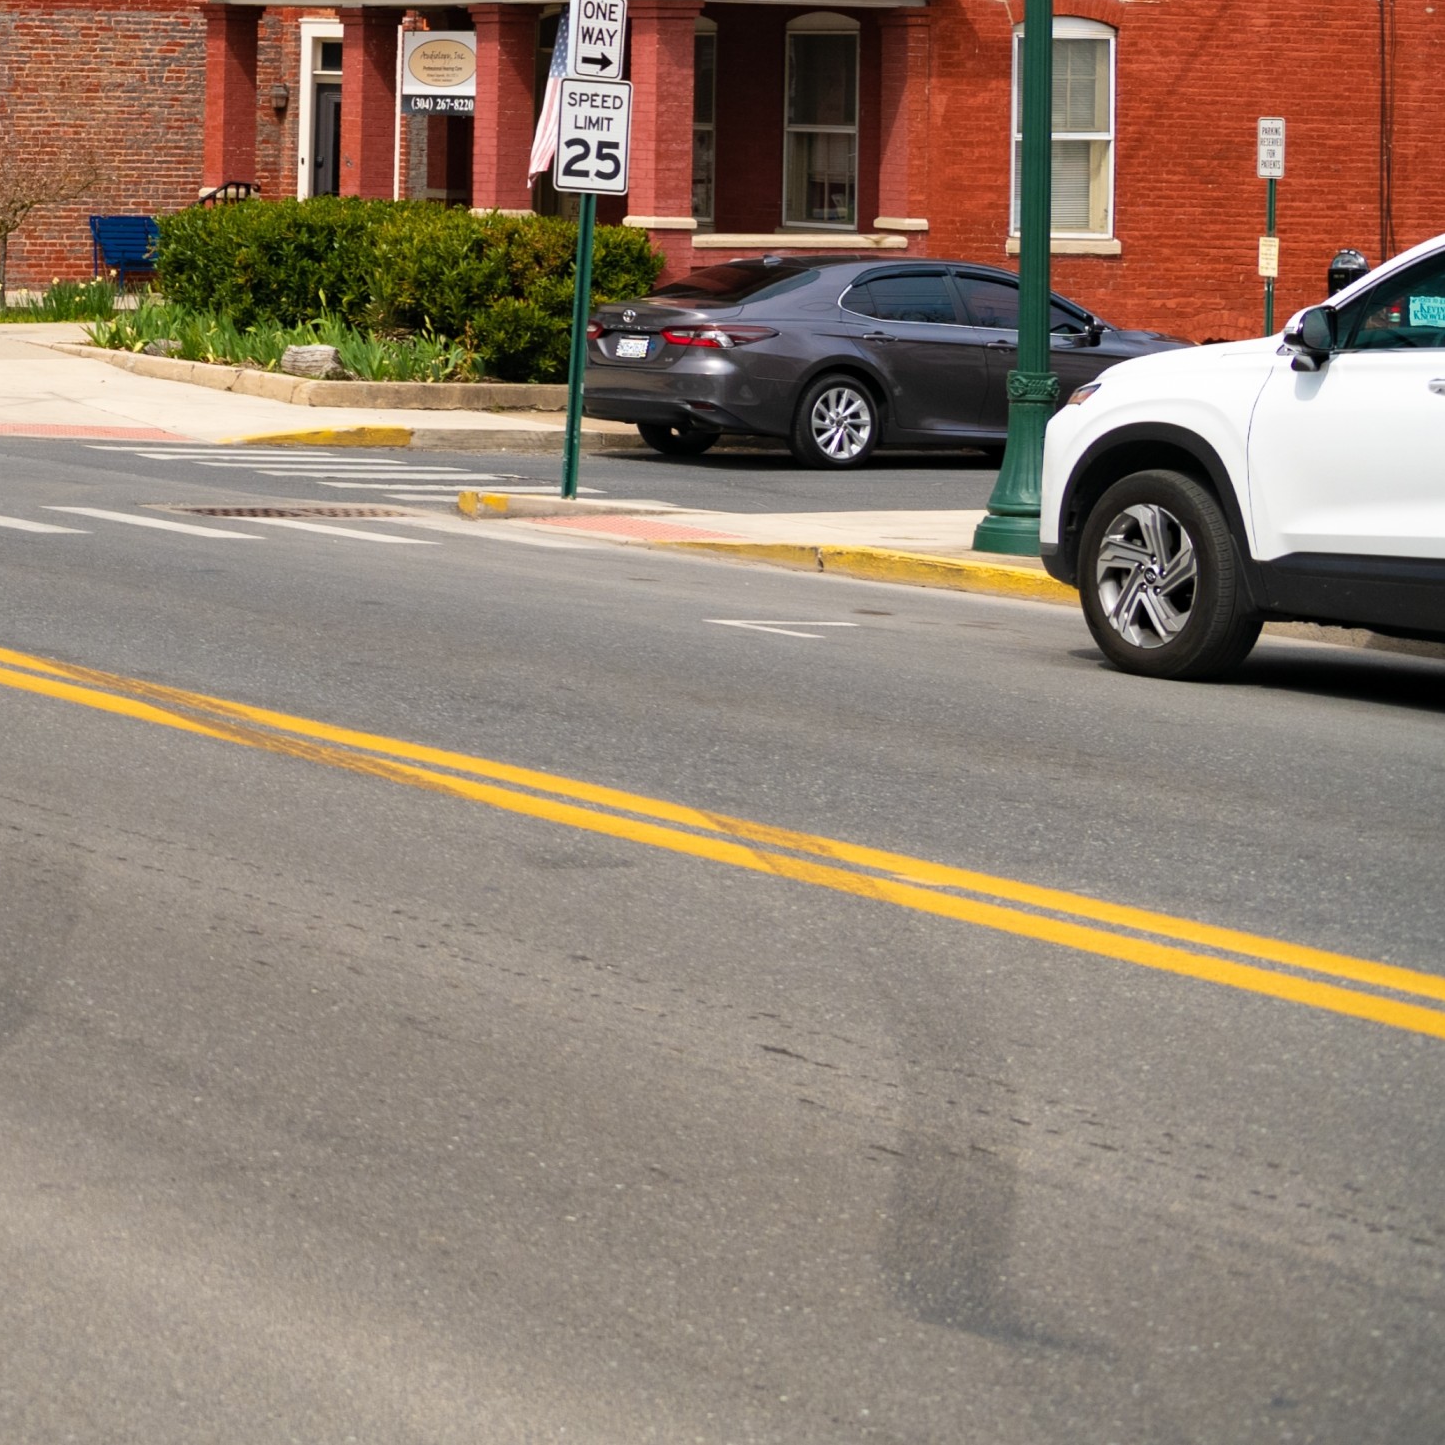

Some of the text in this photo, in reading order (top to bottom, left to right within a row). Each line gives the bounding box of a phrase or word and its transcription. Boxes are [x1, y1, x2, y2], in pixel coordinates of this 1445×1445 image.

[583, 1, 619, 22] ONE
[581, 26, 618, 47] WAY
[411, 97, 474, 111] (304) 267-8220
[567, 92, 624, 110] SPEED
[574, 115, 614, 132] LIMIT
[1262, 126, 1281, 136] PARKING
[1261, 137, 1282, 147] RESERVED
[562, 137, 622, 181] 25
[1267, 149, 1276, 159] FOR
[1261, 159, 1281, 169] PATIENTS
